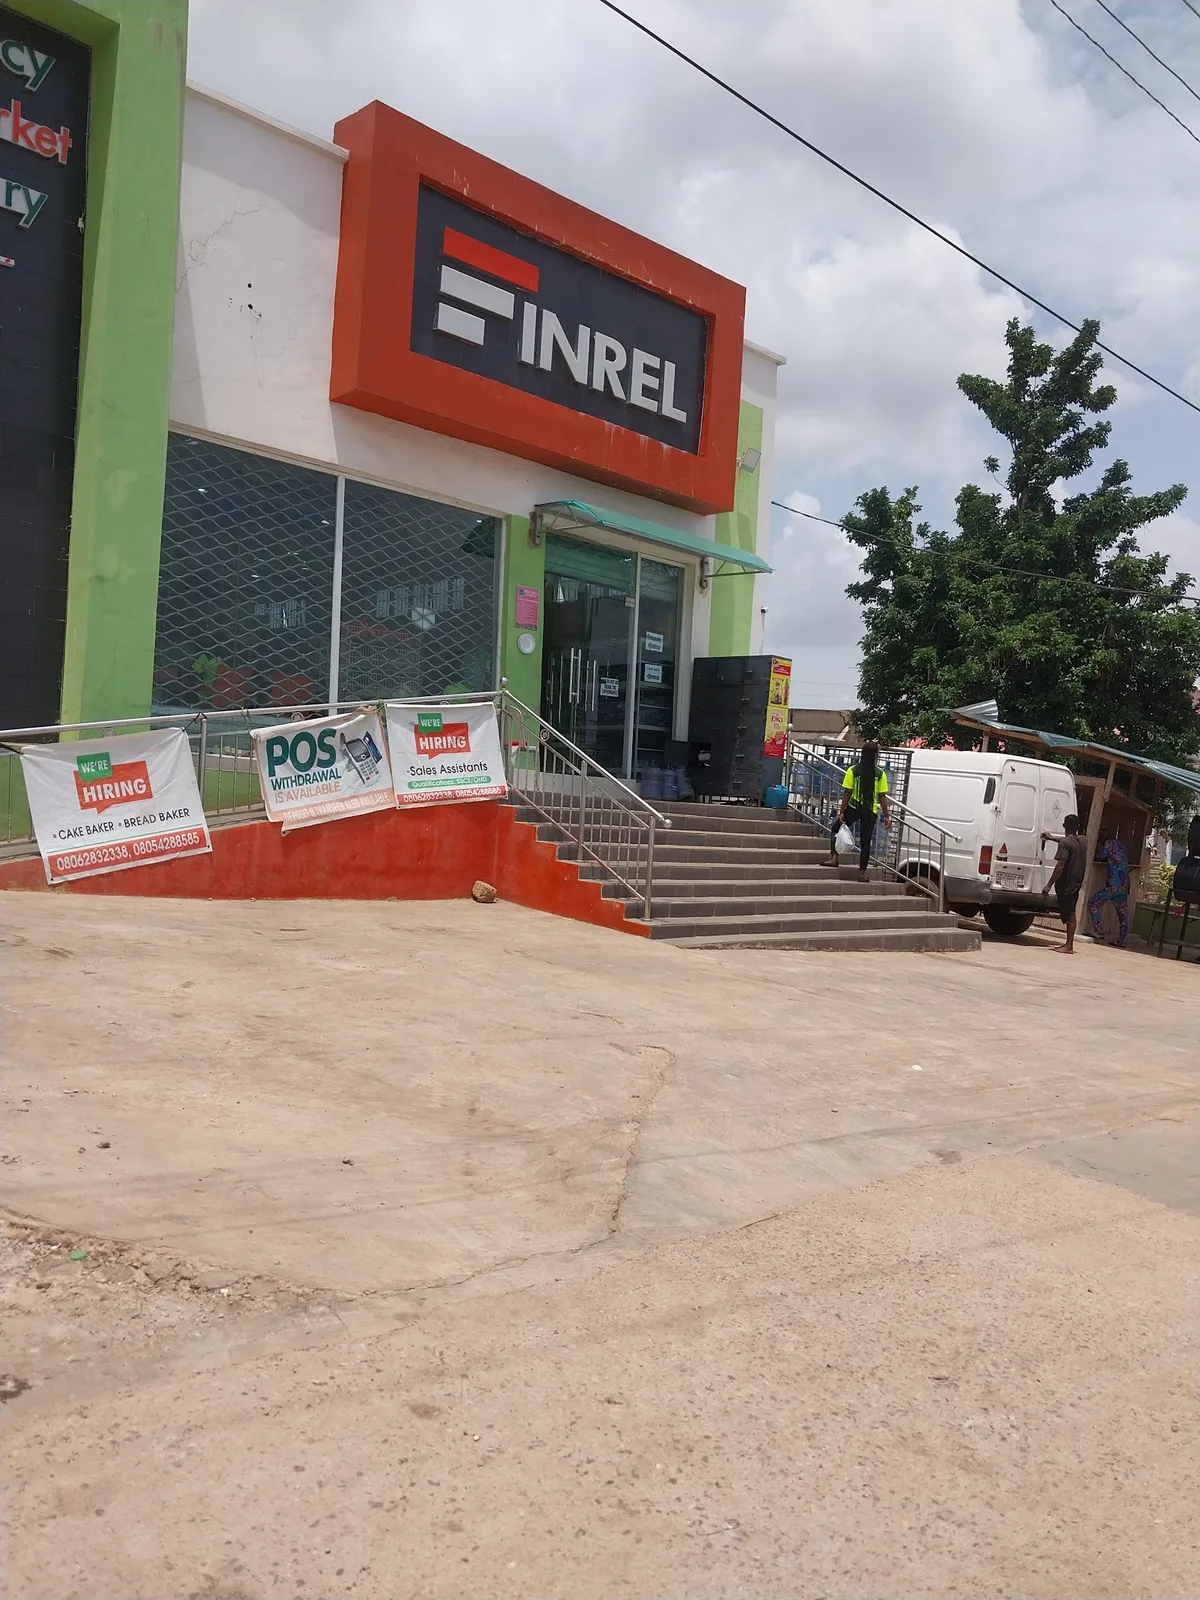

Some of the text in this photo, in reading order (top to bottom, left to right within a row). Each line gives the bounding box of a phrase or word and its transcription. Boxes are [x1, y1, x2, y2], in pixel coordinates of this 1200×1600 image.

[436, 226, 687, 423] FINREL
[420, 719, 441, 728] WE'RE
[266, 727, 337, 778] POS
[419, 736, 467, 750] HIRING
[80, 759, 109, 773] WE'RE
[409, 761, 488, 777] Sales Assistants
[83, 778, 147, 803] HIRING
[271, 768, 342, 791] WITHDRAWAL
[275, 781, 342, 804] IS AVAILABLE
[315, 801, 345, 816] TRANSFER
[344, 798, 361, 810] ALSO
[360, 791, 390, 807] AVAILABLE
[58, 808, 190, 840] CAKE BAKER BREAD BAKER
[56, 832, 200, 871] 08062832338, 08054288585
